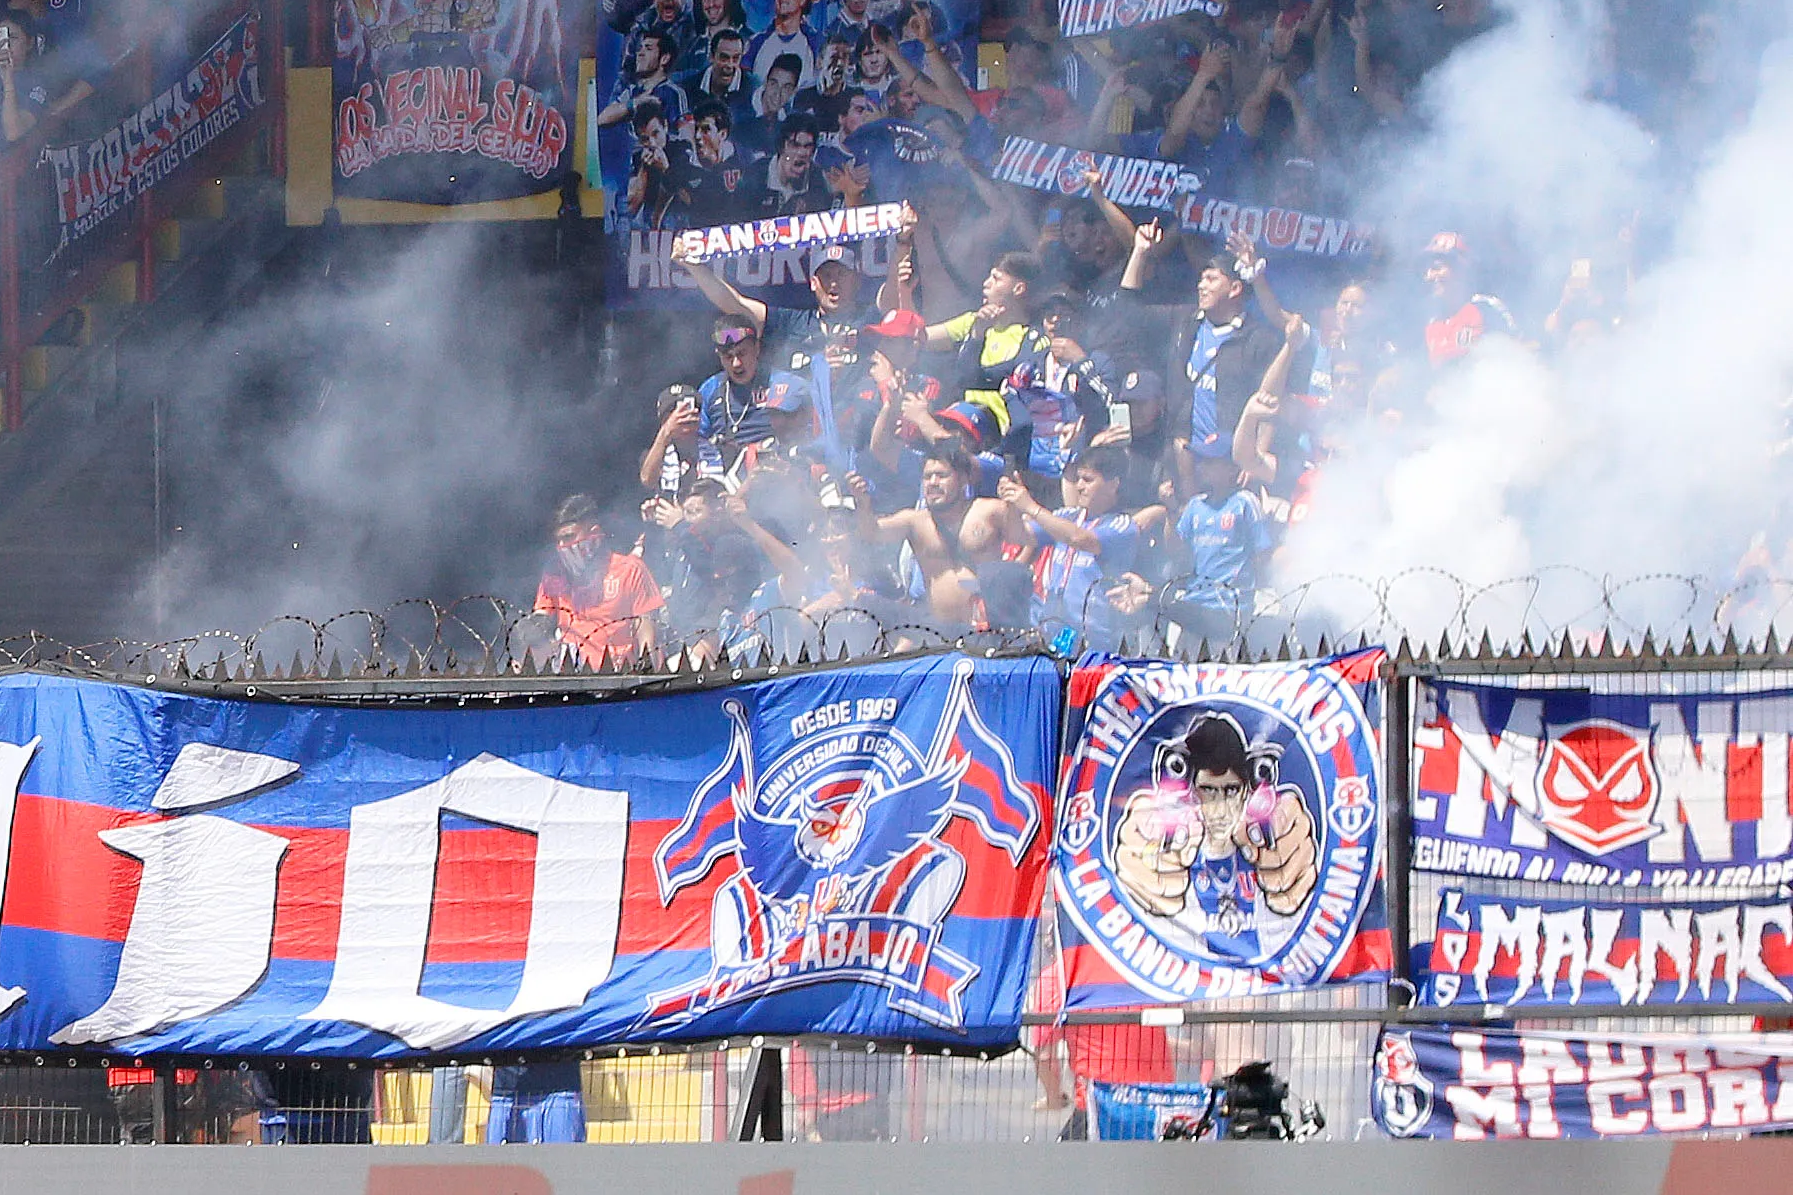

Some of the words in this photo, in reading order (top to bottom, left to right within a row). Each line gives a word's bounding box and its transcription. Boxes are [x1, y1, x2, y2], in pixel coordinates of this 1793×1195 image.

[374, 65, 489, 130] VECINAL
[136, 150, 182, 197] ESTOS
[180, 98, 241, 162] COLORES
[991, 135, 1059, 192] VILLA
[682, 223, 755, 257] SAN
[778, 203, 902, 244] JAVIER
[790, 700, 852, 740] DESDE
[1077, 690, 1144, 767] THE
[759, 735, 858, 808] UNIVERSIDAD
[799, 920, 919, 978] ABAJO
[1067, 858, 1113, 912] LA
[1095, 902, 1202, 996] BANDA
[1433, 887, 1470, 1008] LOS
[1445, 1083, 1562, 1141] MI
